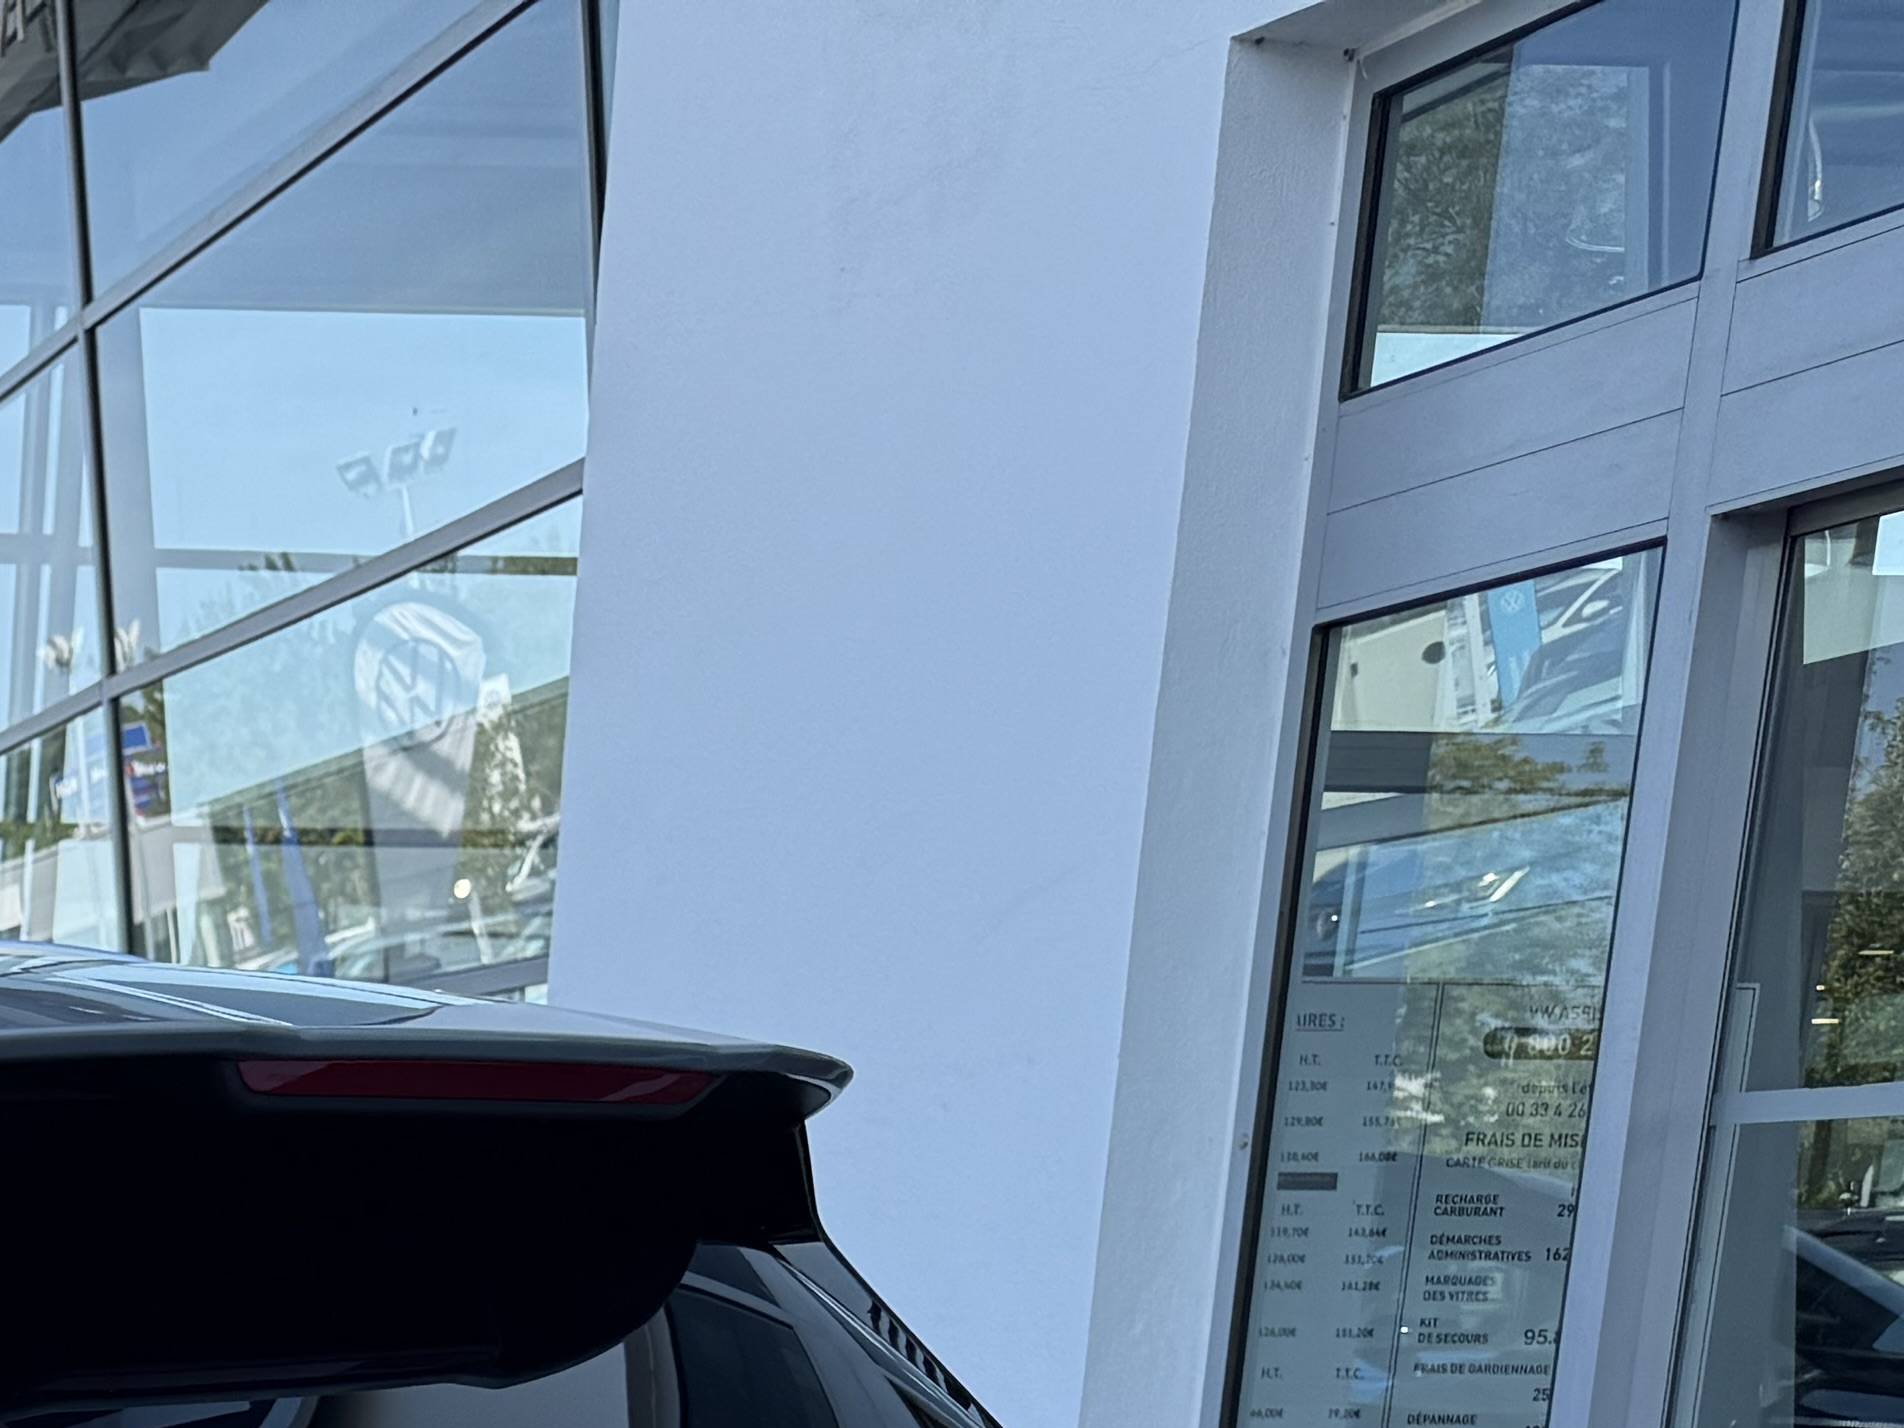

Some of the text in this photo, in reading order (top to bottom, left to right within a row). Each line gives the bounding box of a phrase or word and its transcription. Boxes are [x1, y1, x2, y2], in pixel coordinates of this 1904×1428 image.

[1464, 1131, 1585, 1149] FRAIS DE MIS
[1435, 1193, 1500, 1206] RECHARGE
[1433, 1206, 1505, 1218] CARBURANT
[1430, 1231, 1502, 1246] DÉMARCHES
[1428, 1249, 1532, 1262] ADMINISTRATIVES
[1423, 1290, 1445, 1302] DES
[1419, 1317, 1439, 1328] KIT
[1417, 1332, 1434, 1344] DE
[1436, 1332, 1489, 1345] SECOURS
[1450, 1363, 1466, 1376] DE
[1468, 1363, 1551, 1377] GARDIENNAGE
[1407, 1411, 1478, 1426] DÉPANNAGE
